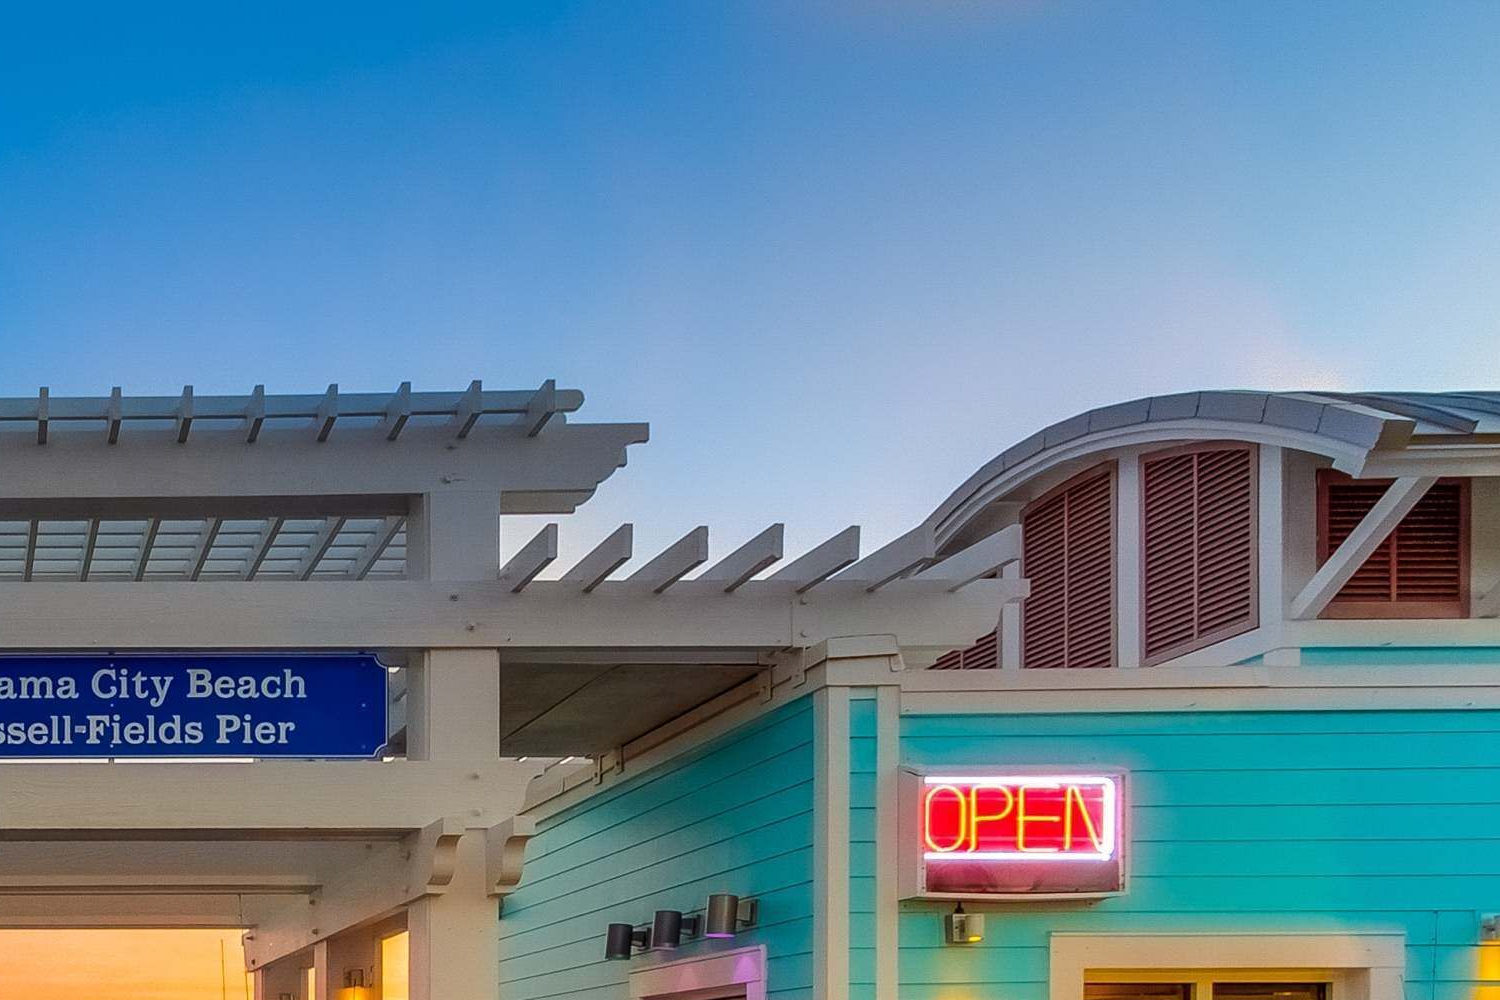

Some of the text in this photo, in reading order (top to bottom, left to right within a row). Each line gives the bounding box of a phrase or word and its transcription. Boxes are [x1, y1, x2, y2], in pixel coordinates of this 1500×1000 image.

[91, 668, 174, 707] City
[186, 668, 307, 698] Beach
[216, 714, 295, 744] Pier
[925, 784, 1106, 852] OPEN
